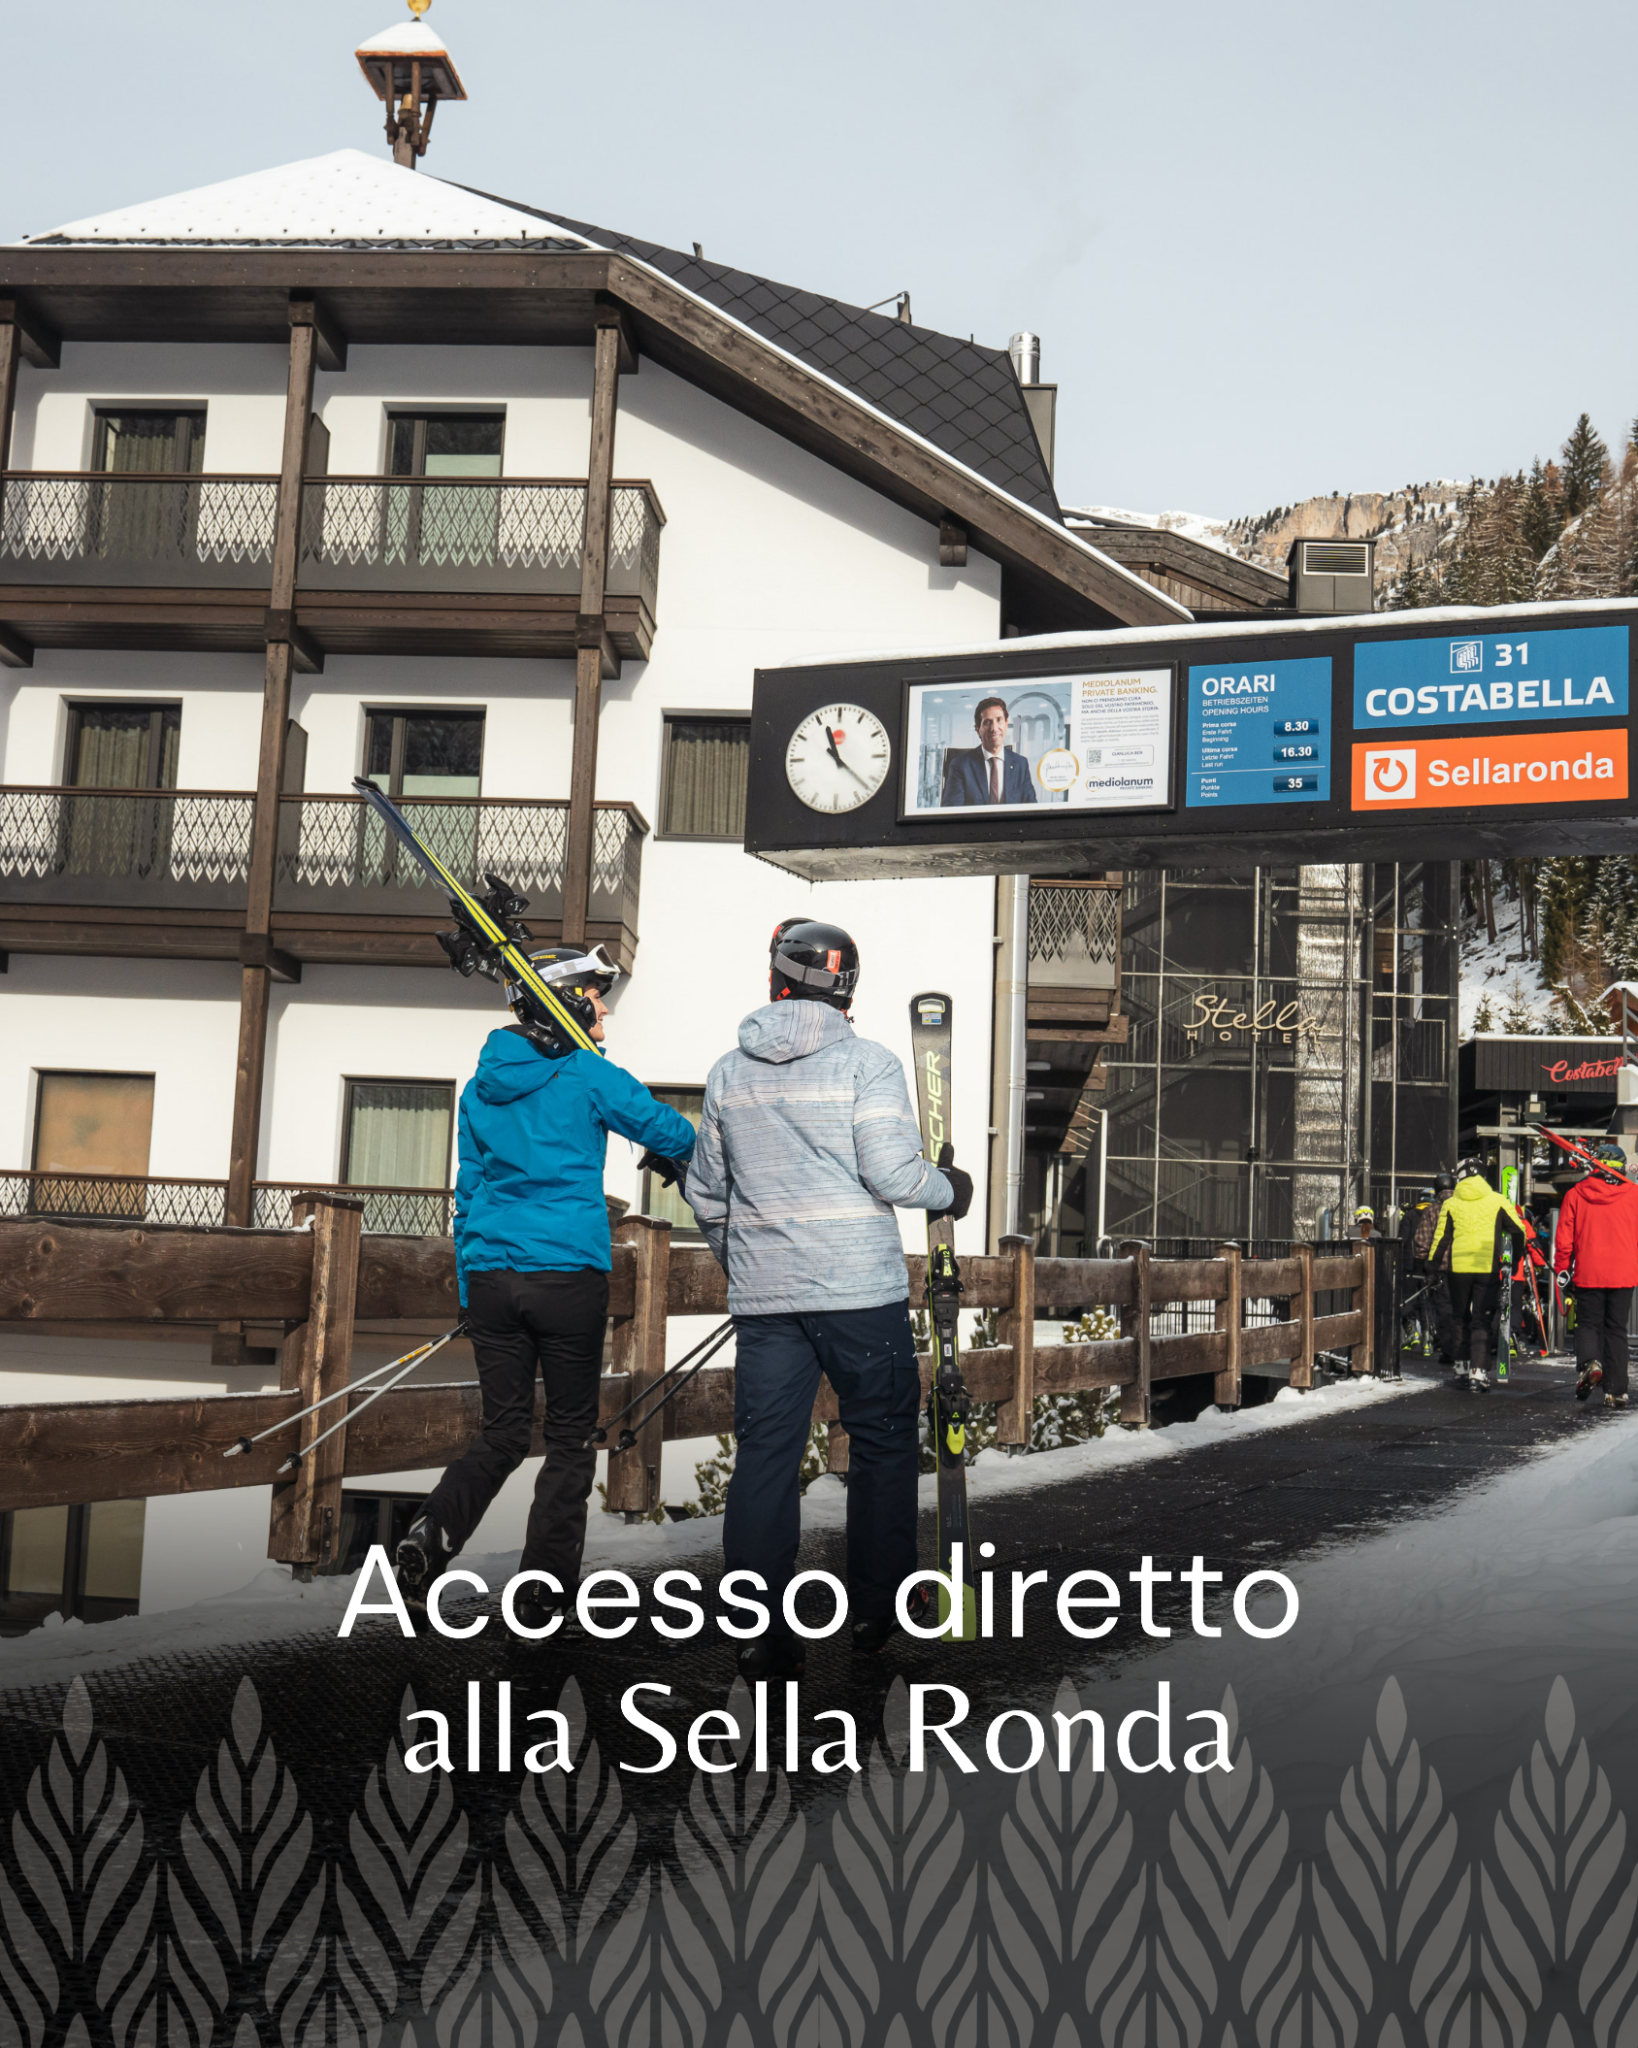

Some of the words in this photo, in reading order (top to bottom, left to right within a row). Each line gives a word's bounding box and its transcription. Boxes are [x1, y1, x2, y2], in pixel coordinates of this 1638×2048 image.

[1494, 641, 1529, 668] 31
[1082, 678, 1141, 688] MEDIOLANUM
[1202, 674, 1275, 696] ORARI
[1082, 688, 1115, 697] PRIVATE
[1365, 676, 1615, 718] COSTABELLA
[1202, 696, 1269, 707] BETRIEBSZEITEN
[1202, 706, 1239, 716] OPENING
[1240, 705, 1269, 714] HOURS
[1284, 721, 1309, 732] 8.30
[1202, 736, 1229, 744] Beginning
[1281, 746, 1312, 758] 16.30
[1427, 752, 1615, 788] Sellaronda
[1088, 776, 1154, 788] mediolanum
[1287, 777, 1303, 789] 35
[1183, 995, 1326, 1031] Stella
[1187, 1030, 1321, 1045] HOTEL
[926, 1050, 944, 1168] SCHER
